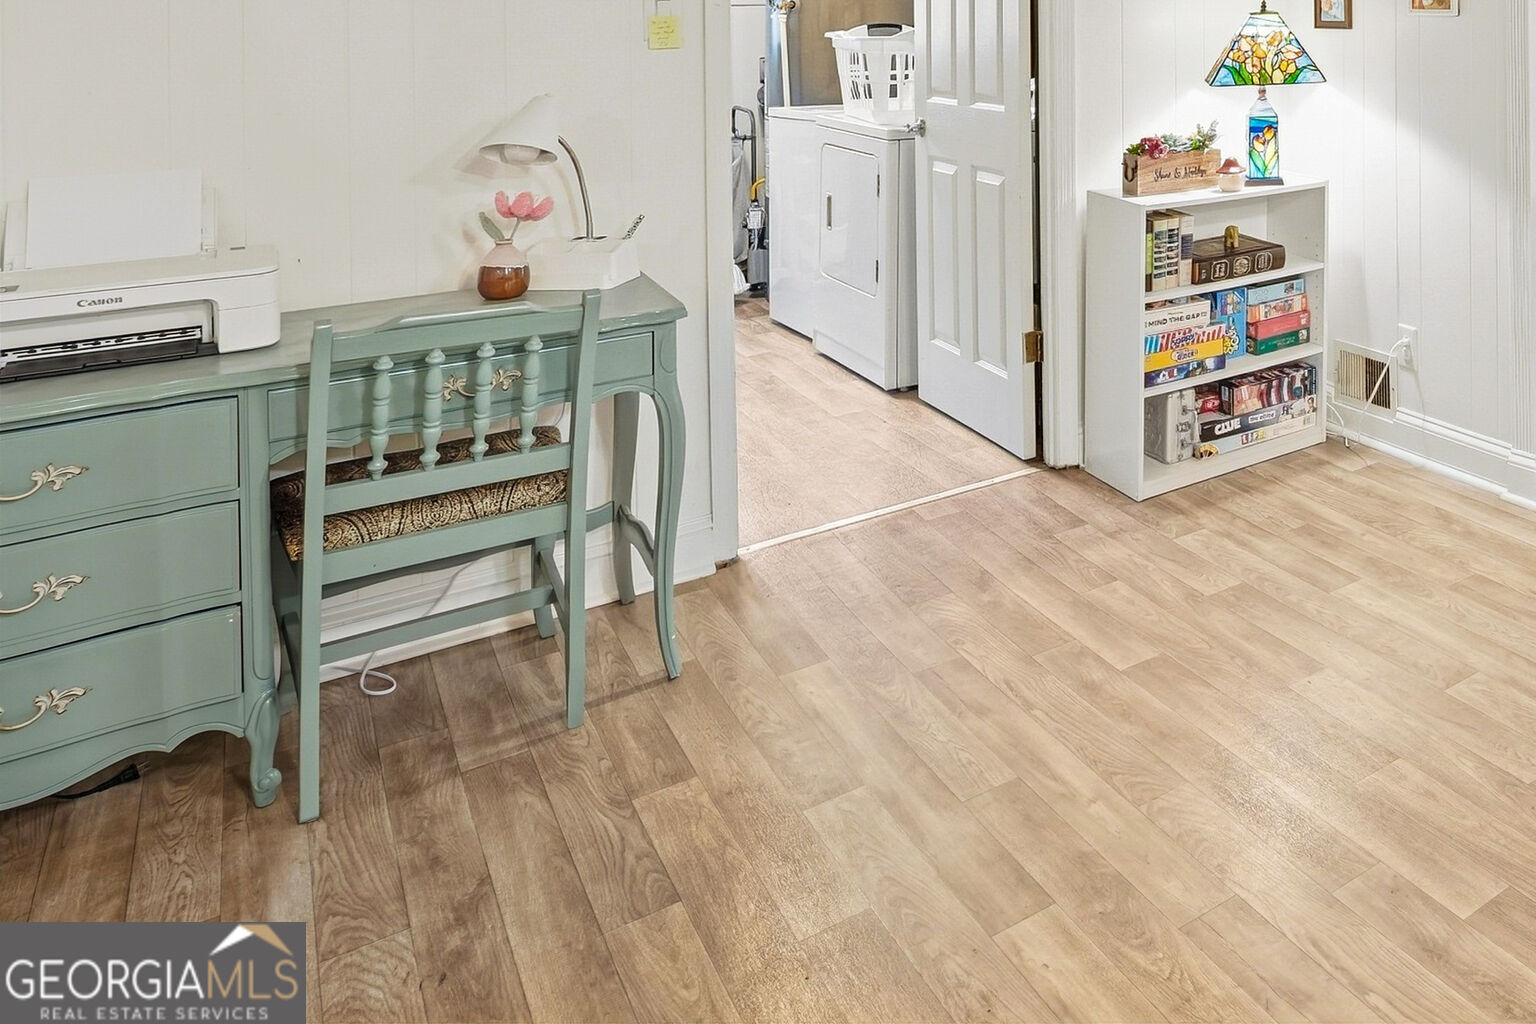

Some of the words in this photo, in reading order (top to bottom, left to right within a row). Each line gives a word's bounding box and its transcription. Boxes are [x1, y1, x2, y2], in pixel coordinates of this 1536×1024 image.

[77, 297, 123, 308] Canon
[1148, 318, 1168, 327] MIND
[1185, 312, 1201, 321] GAP
[1214, 417, 1242, 436] CLUE
